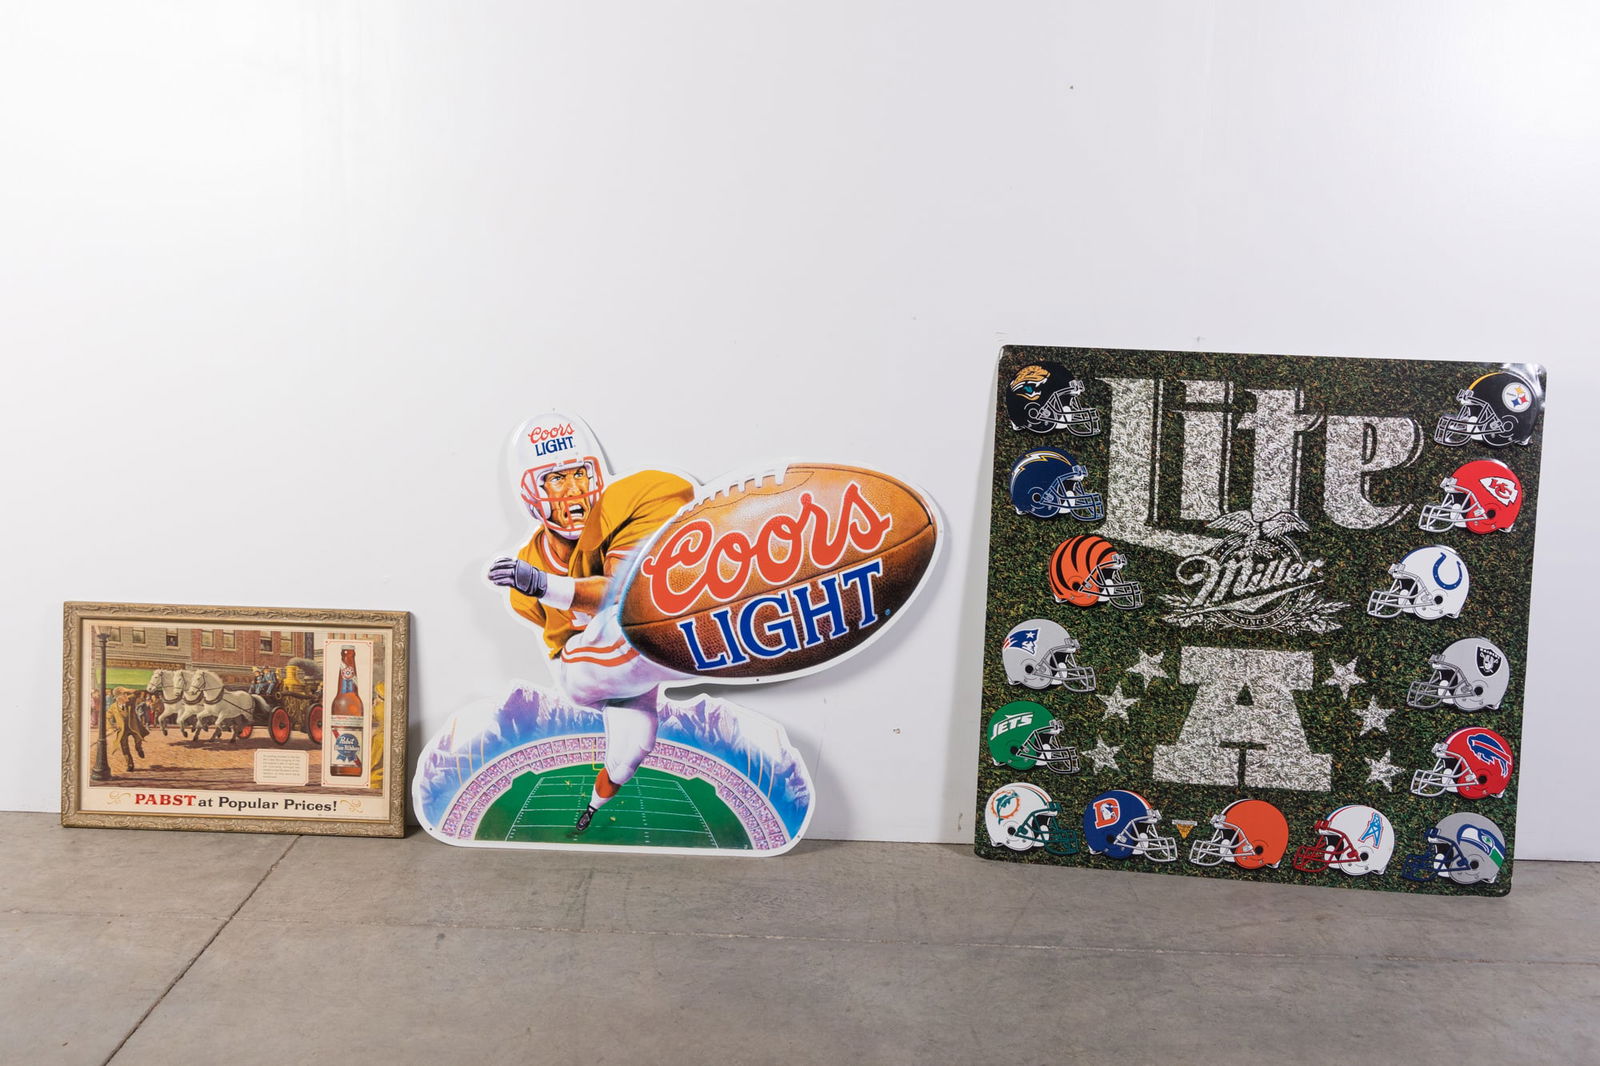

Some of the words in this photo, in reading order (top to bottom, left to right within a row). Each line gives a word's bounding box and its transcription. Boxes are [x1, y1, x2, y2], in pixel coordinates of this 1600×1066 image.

[528, 423, 575, 444] Coors
[535, 436, 574, 456] LIGHT
[1094, 377, 1424, 557] Lite
[642, 482, 893, 614] Coors
[1176, 551, 1326, 607] Miller
[678, 561, 884, 671] LIGHT
[990, 712, 1034, 740] JETS
[134, 793, 197, 806] PABST
[198, 797, 213, 808] at
[218, 797, 279, 811] Popular
[284, 798, 337, 812] Prices!
